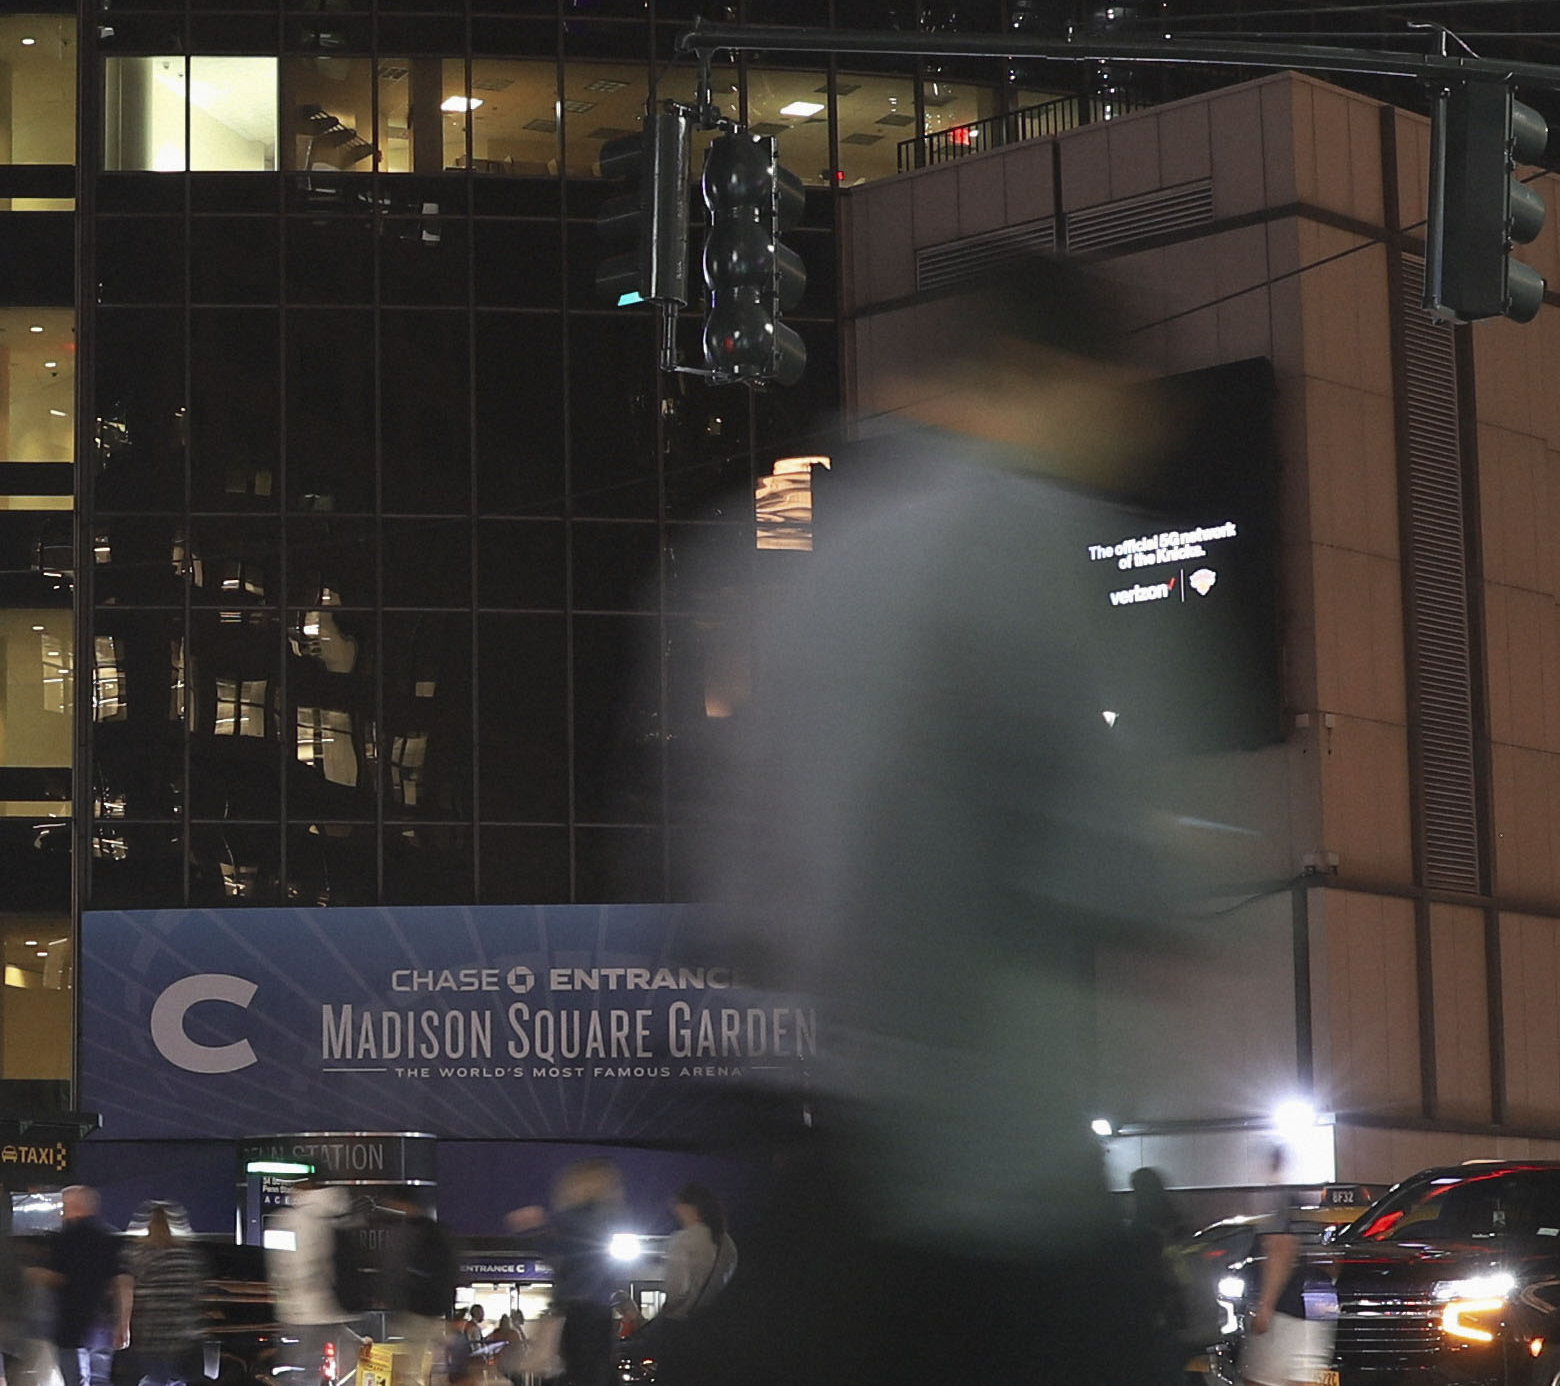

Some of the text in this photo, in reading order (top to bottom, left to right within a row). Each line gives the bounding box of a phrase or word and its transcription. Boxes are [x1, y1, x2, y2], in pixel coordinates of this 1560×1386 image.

[1088, 544, 1113, 560] The
[1110, 584, 1168, 605] verizon
[391, 969, 500, 992] CHASE
[150, 973, 259, 1074] C
[321, 1001, 818, 1062] MADISON SQUARE GARDEN
[395, 1066, 743, 1079] THE WORLD'S MOST FAMOUS ARENA
[19, 1146, 53, 1165] TAXI
[516, 1264, 525, 1273] C
